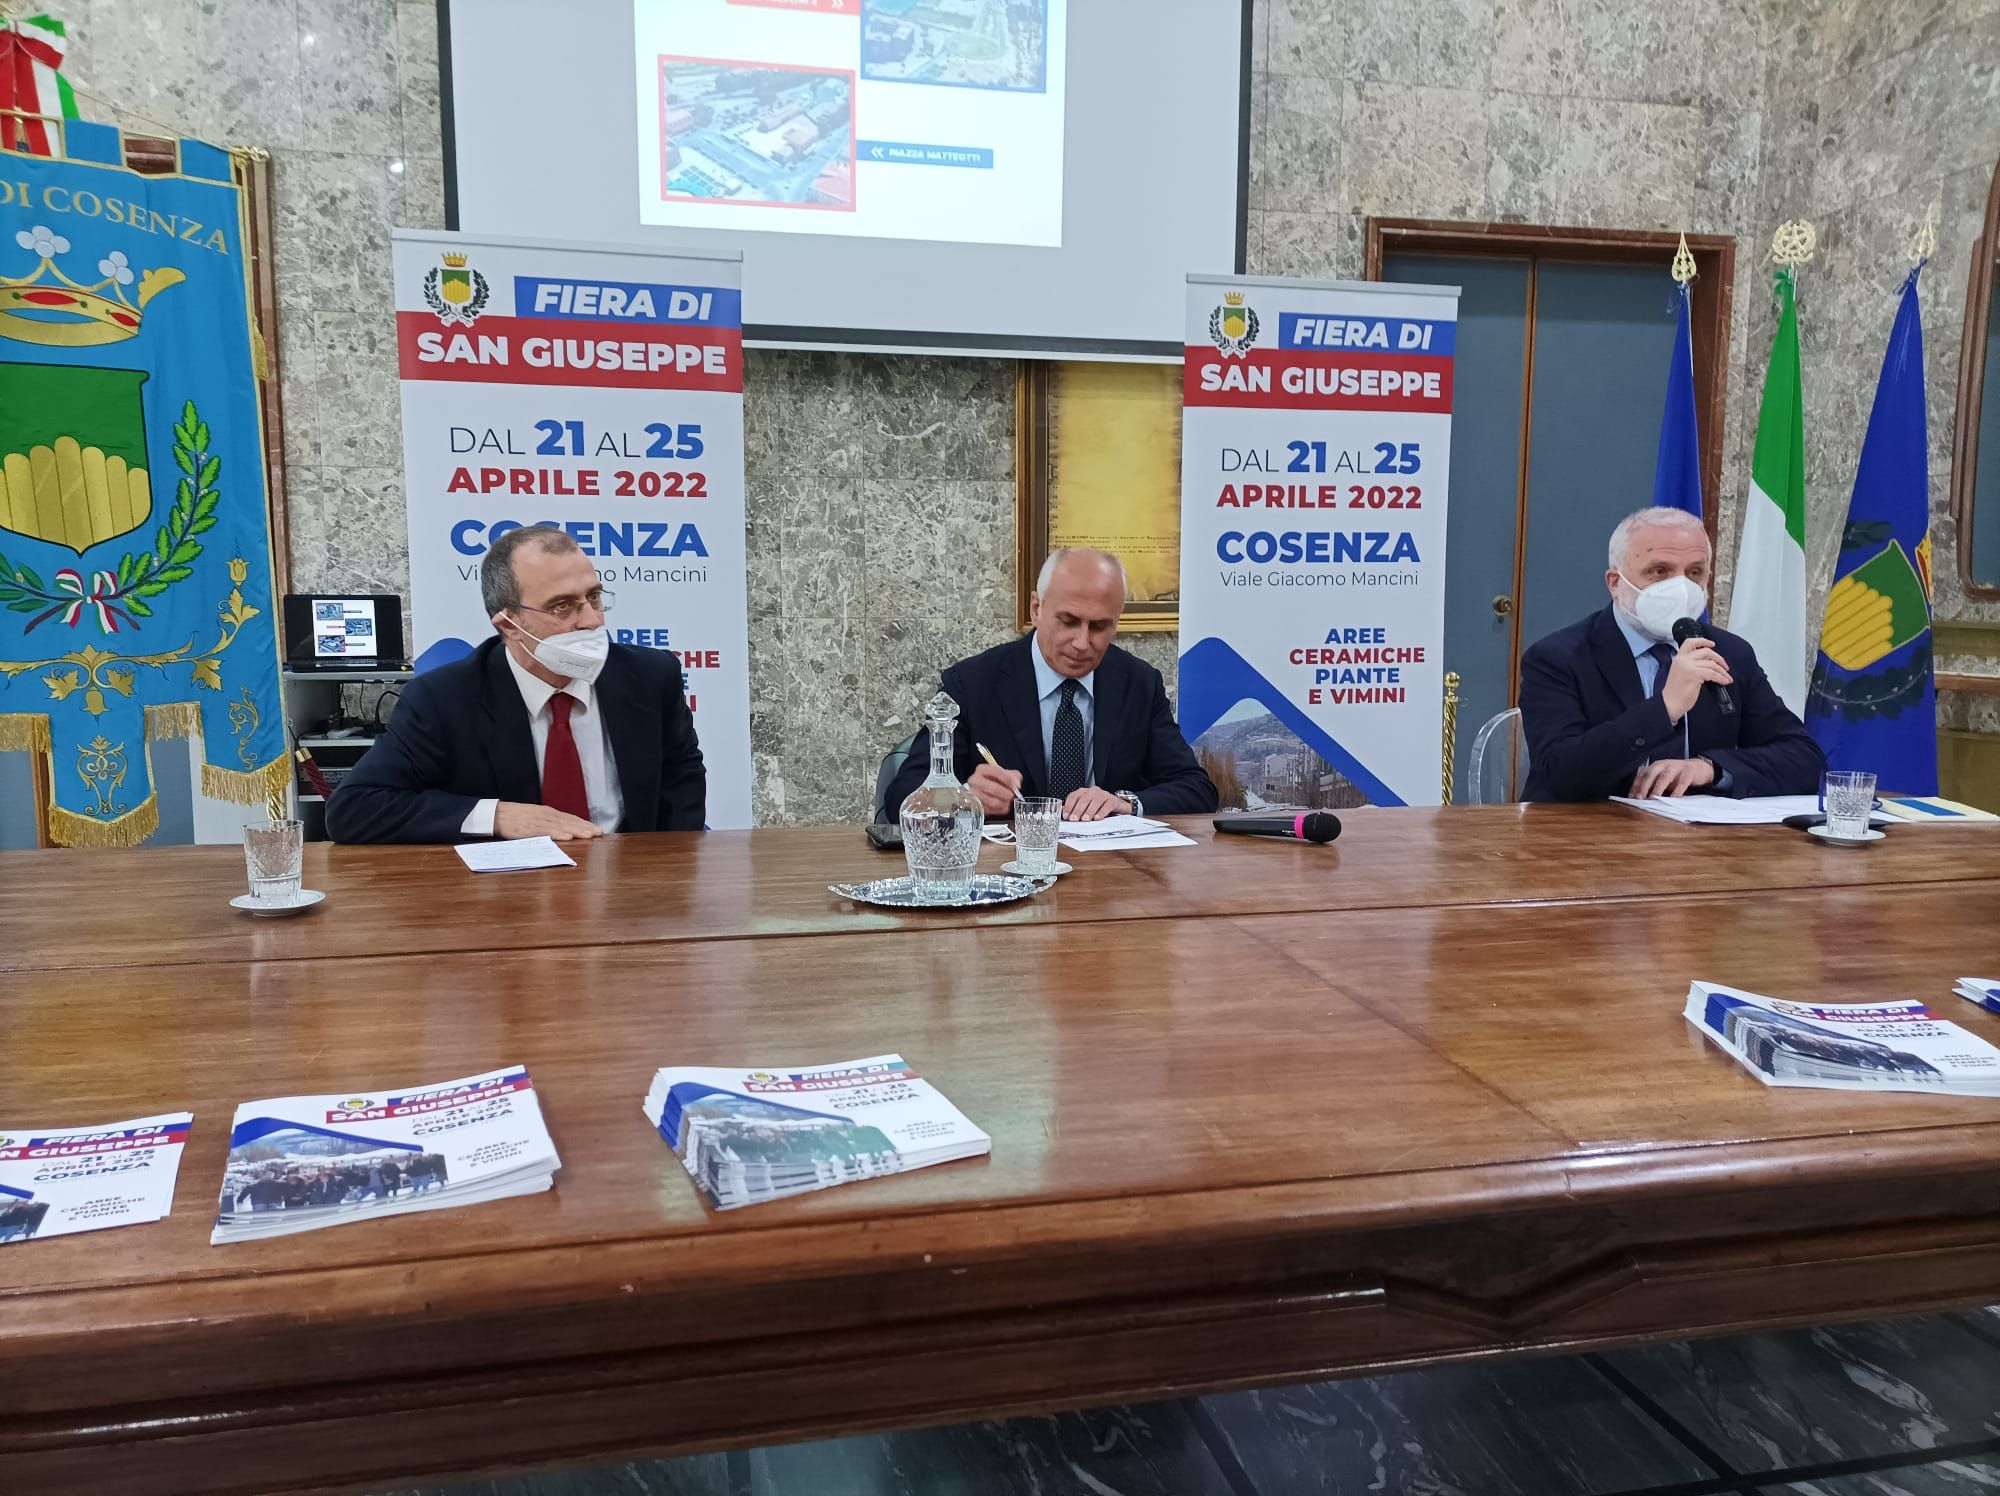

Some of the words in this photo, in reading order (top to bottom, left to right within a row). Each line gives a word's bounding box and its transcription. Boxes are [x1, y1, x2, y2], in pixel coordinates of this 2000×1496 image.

[889, 147, 924, 160] PIAZZA
[927, 150, 981, 163] MATTEOTTI
[43, 186, 229, 256] COSENZA
[534, 283, 657, 318] FIERA
[668, 291, 713, 321] DI
[1293, 318, 1389, 348] FIERA
[1398, 323, 1433, 350] DI
[417, 332, 509, 365] SAN
[521, 337, 727, 375] GIUSEPPE
[1200, 363, 1271, 393] SAN
[1281, 366, 1441, 398] GIUSEPPE
[450, 427, 526, 455] DAL
[534, 419, 585, 456] 21
[595, 432, 641, 458] AL
[643, 422, 704, 459] 25
[1221, 448, 1279, 473] DAL
[1286, 440, 1327, 473] 21
[1335, 450, 1371, 474] AL
[1374, 442, 1421, 475] 25
[447, 467, 600, 496] APRILE
[614, 470, 708, 498] 2022
[1216, 484, 1337, 508] APRILE
[1348, 485, 1422, 509] 2022
[450, 519, 710, 558] CENZA
[1216, 531, 1420, 563] COSENZA
[624, 565, 708, 583] Mancini
[1220, 571, 1263, 587] Viale
[1267, 571, 1346, 587] Giacomo
[1352, 570, 1419, 586] Mancini
[1325, 628, 1386, 644] AREE
[1289, 647, 1425, 665] CERAMICHE
[1315, 667, 1400, 684] PIANTE
[1308, 689, 1322, 705] E
[1331, 687, 1405, 704] VIMINI
[800, 1072, 907, 1091] GIUSEPPE
[802, 1067, 864, 1081] FIERA
[867, 1063, 889, 1072] DI
[400, 1084, 472, 1105] FIERA
[478, 1077, 505, 1089] DI
[833, 1092, 921, 1110] COSENZA
[331, 1110, 386, 1121] SAN
[392, 1084, 516, 1115] GIUSEPPE
[445, 1108, 464, 1117] 21
[412, 1109, 514, 1136] COSENZA
[43, 1131, 125, 1145] FIERA
[133, 1126, 165, 1136] DI
[28, 1136, 170, 1157] GIUSEPPE
[80, 1155, 103, 1163] 21
[129, 1149, 156, 1157] 25
[34, 1162, 151, 1181] COSENZA
[37, 1161, 106, 1173] APRILE
